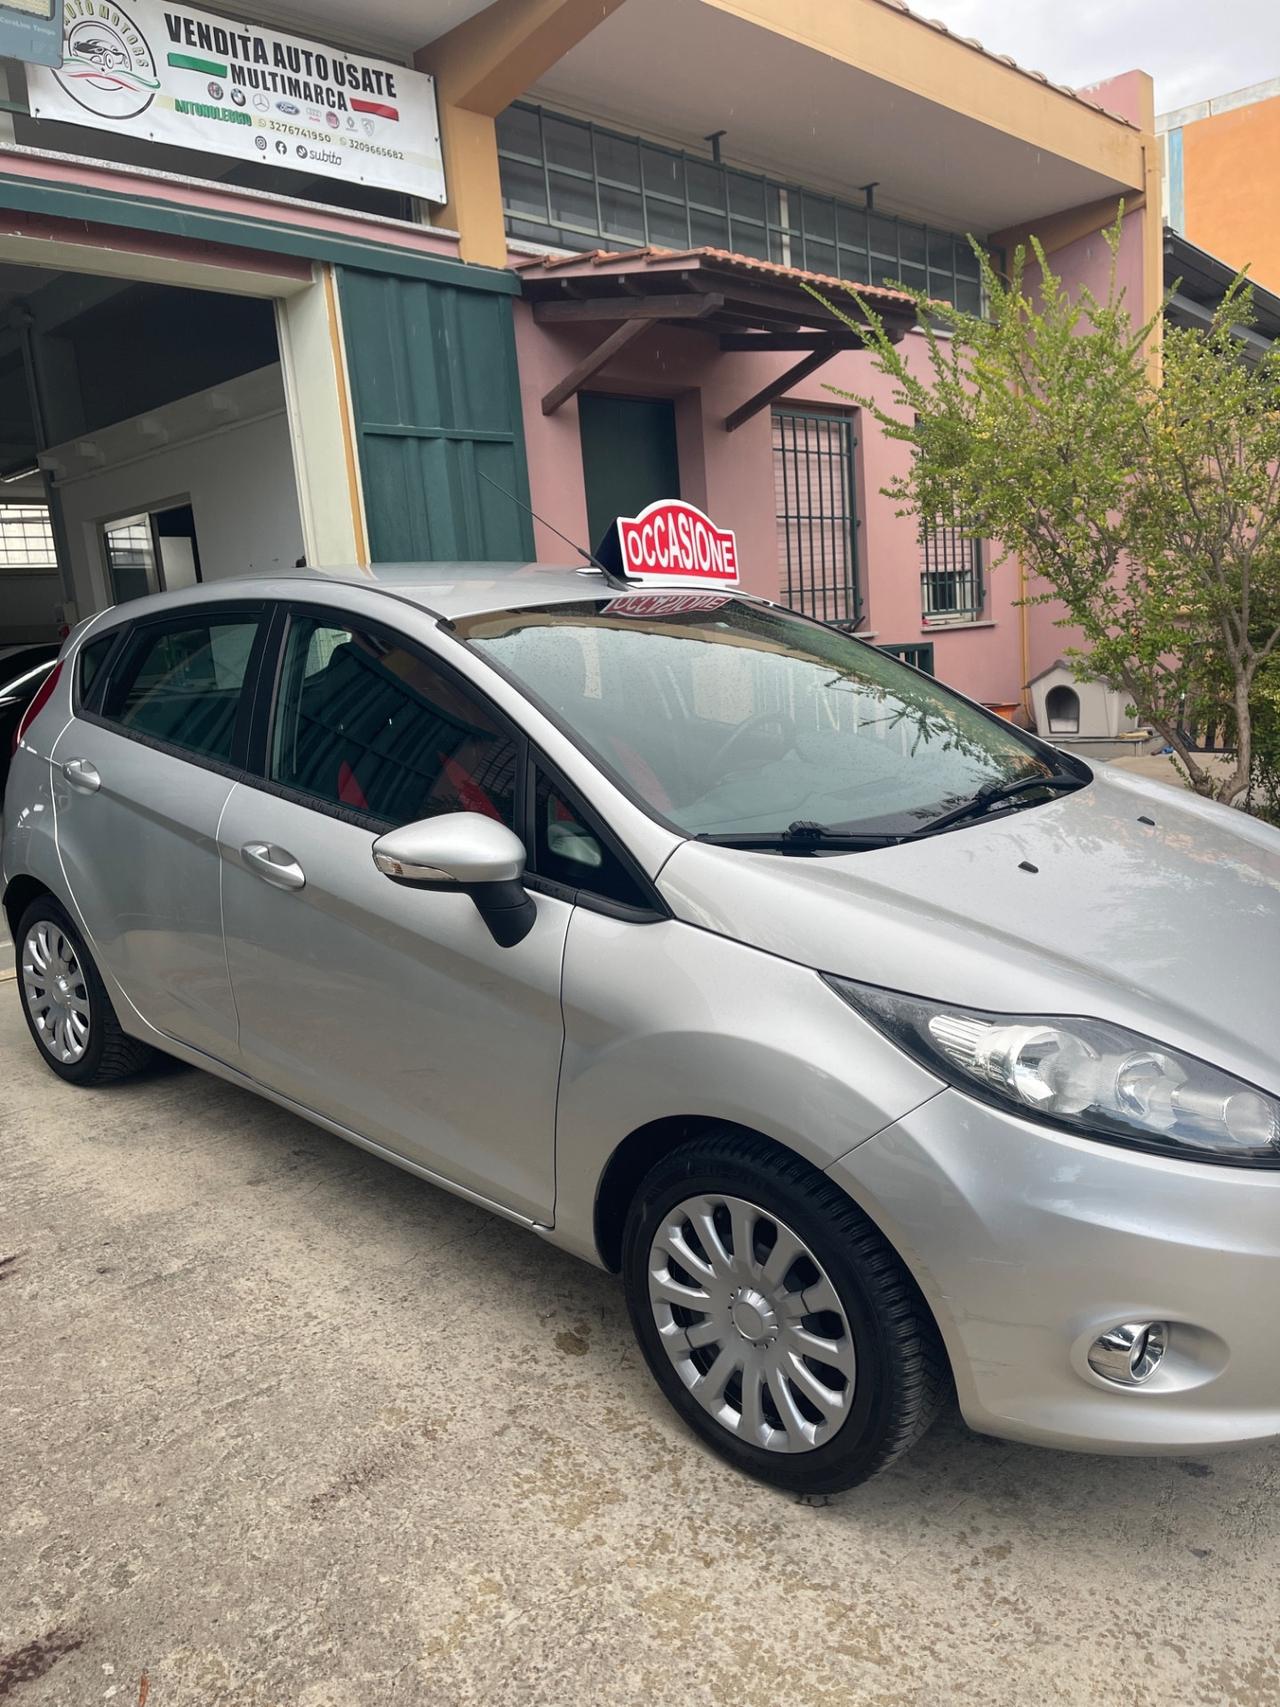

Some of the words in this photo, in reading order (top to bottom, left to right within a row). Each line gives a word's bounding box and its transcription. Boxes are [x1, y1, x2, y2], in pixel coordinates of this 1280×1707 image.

[164, 13, 269, 65] VENDITA
[273, 41, 329, 82] AUTO
[331, 59, 397, 98] USATE
[230, 63, 348, 112] MULTIMARCA
[269, 120, 332, 143] 3276741950
[348, 138, 405, 161] 3209665682
[309, 148, 342, 166] subito
[626, 511, 735, 574] OCCASIONE
